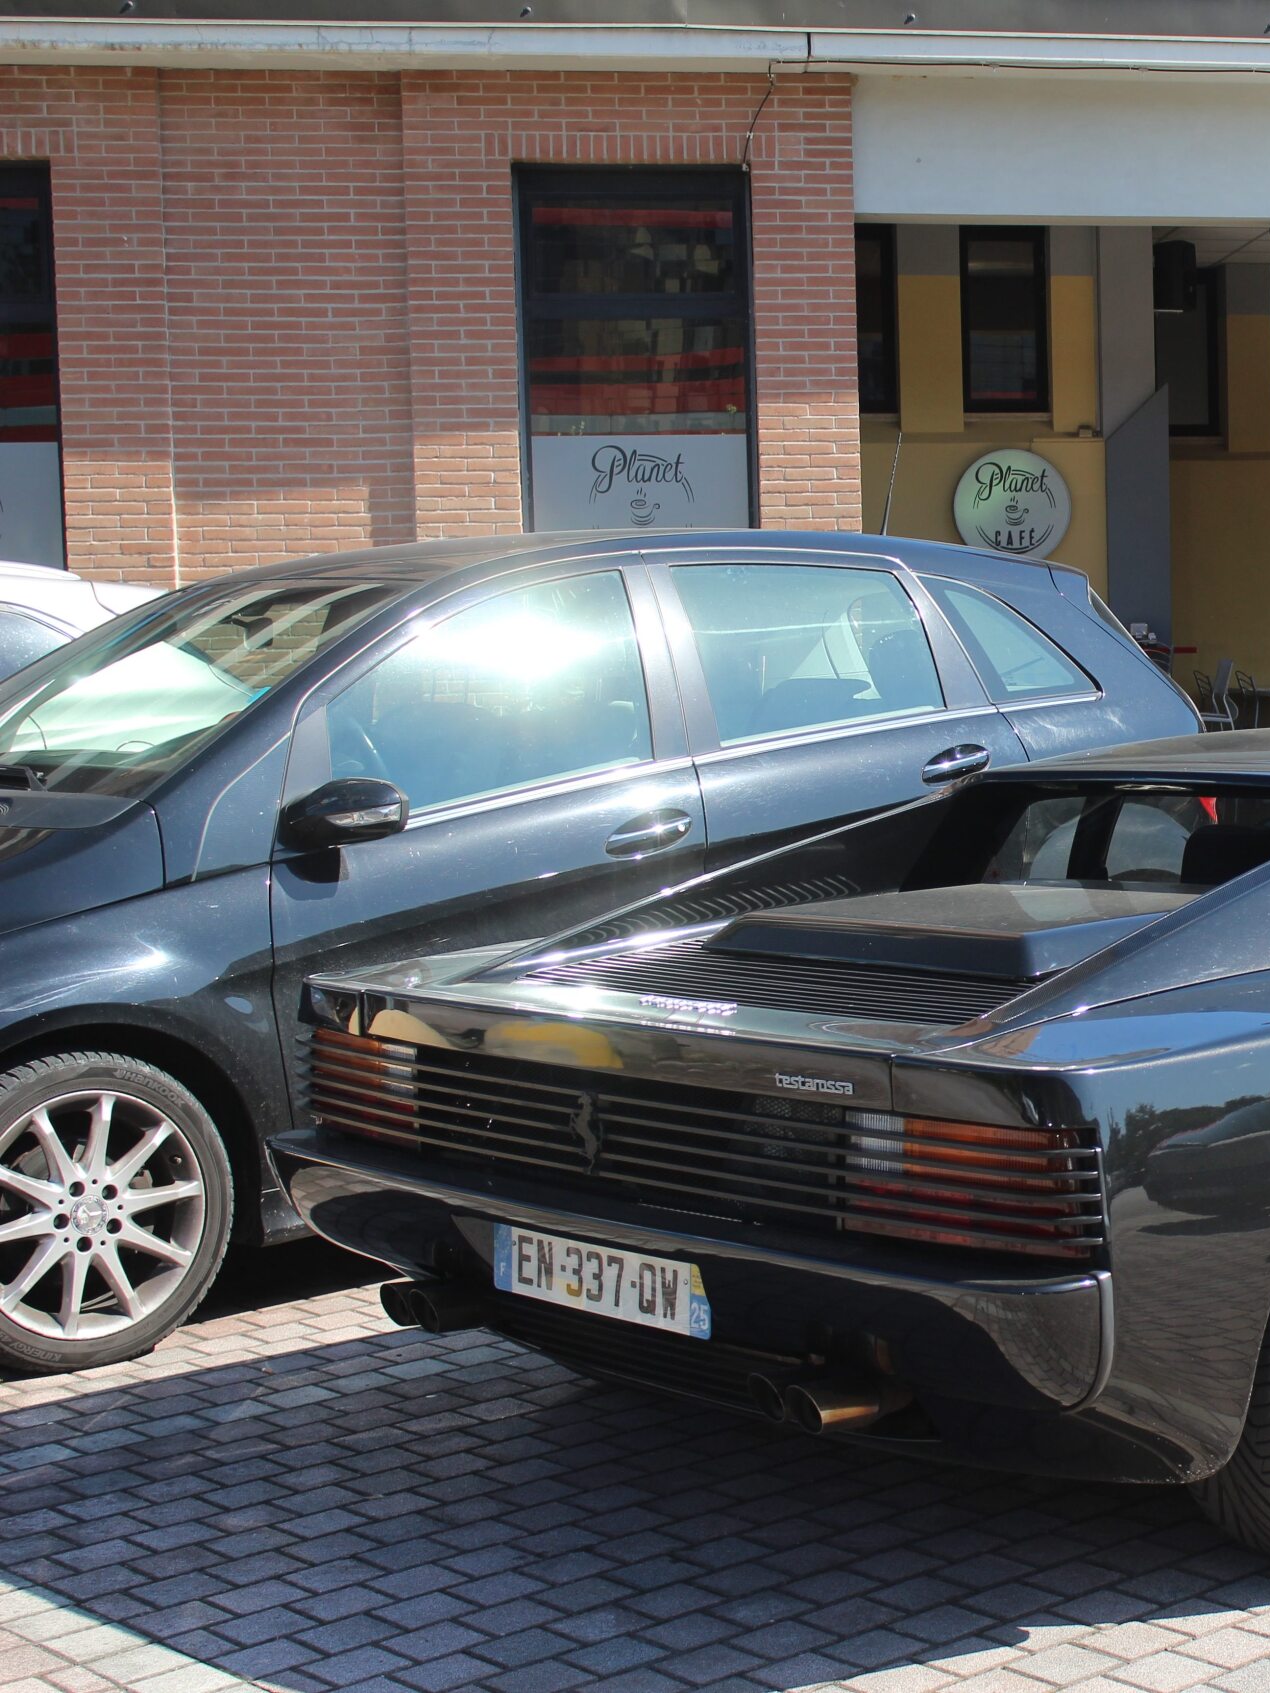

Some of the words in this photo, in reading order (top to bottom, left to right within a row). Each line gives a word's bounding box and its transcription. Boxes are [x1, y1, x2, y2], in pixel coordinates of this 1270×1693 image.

[591, 445, 684, 494] Planet
[975, 461, 1048, 501] Planet
[775, 1072, 854, 1095] testarossa
[517, 1234, 679, 1321] EN-337-QW
[690, 1302, 709, 1331] 25
